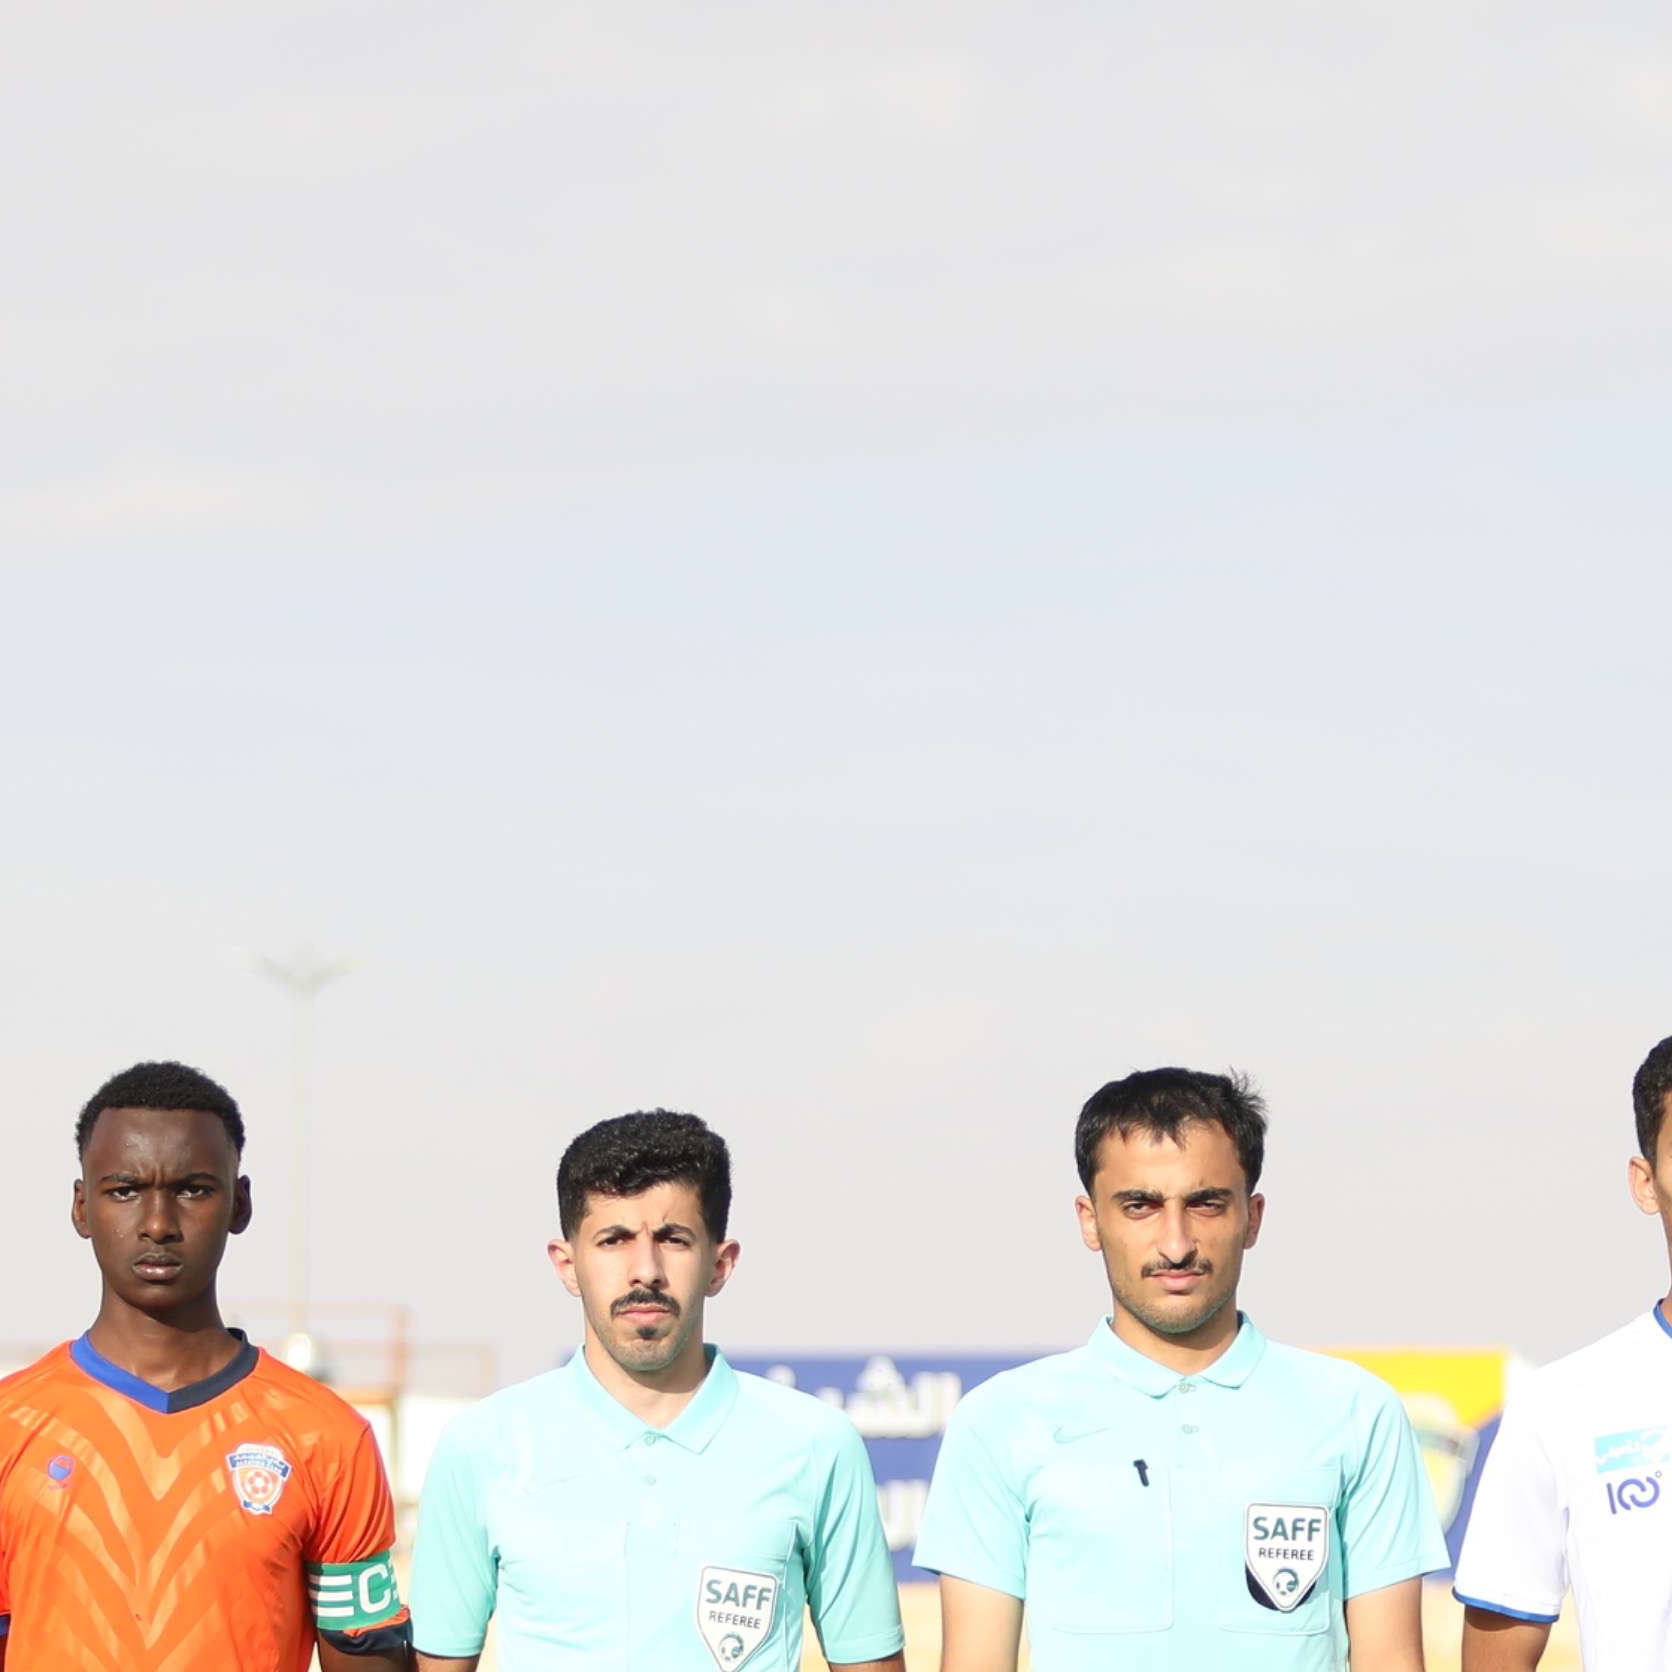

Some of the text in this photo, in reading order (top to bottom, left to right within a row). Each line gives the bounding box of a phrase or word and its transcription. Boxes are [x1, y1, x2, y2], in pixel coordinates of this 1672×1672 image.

[1252, 1516, 1322, 1542] SAFF
[1258, 1547, 1315, 1561] REFEREE
[358, 1563, 392, 1614] C
[705, 1579, 773, 1611] SAFF
[709, 1610, 762, 1629] REFEREE
